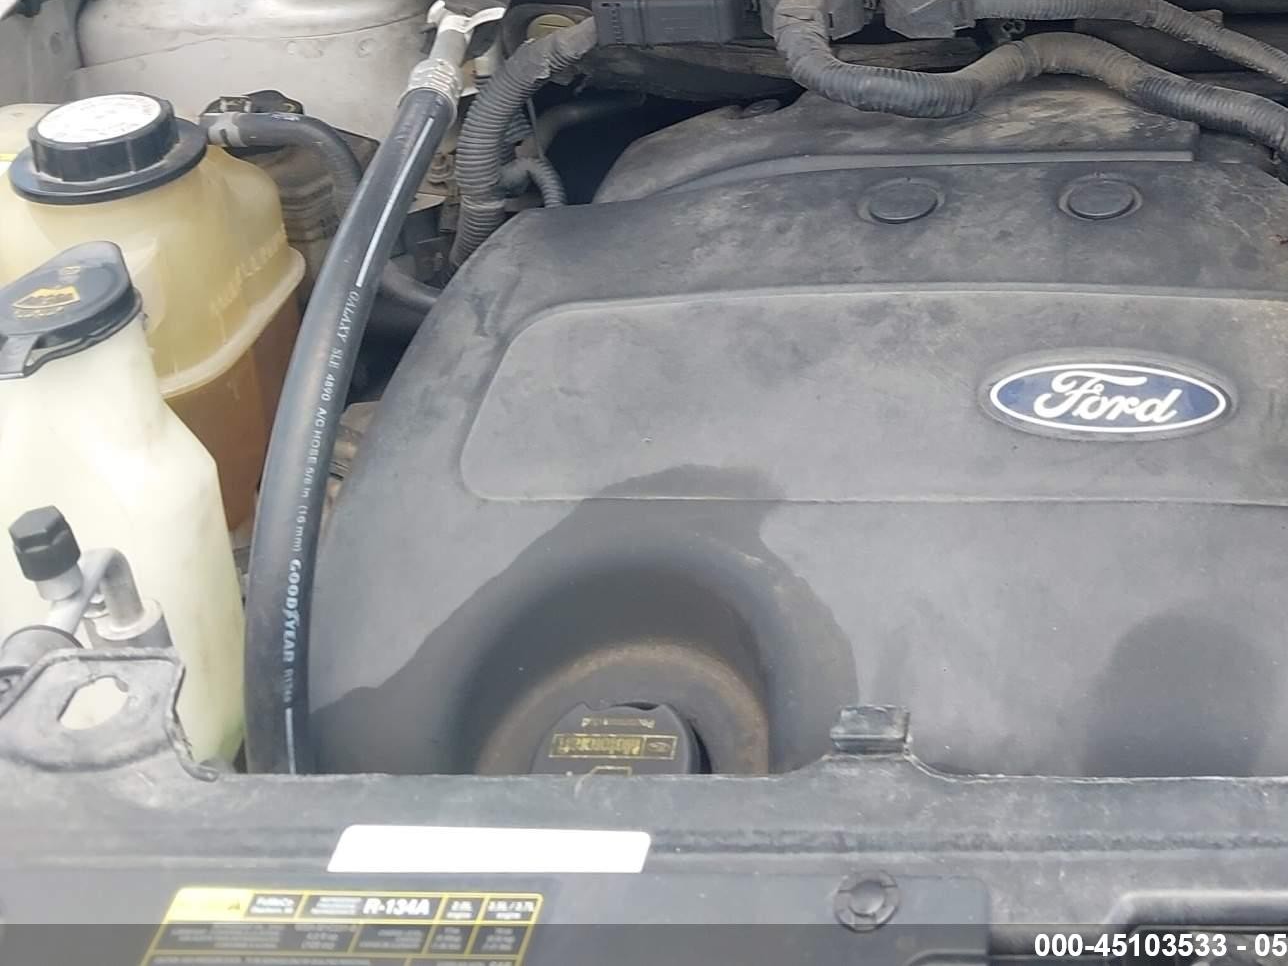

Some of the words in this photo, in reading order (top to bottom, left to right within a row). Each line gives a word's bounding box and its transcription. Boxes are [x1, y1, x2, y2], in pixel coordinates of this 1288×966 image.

[1033, 370, 1182, 423] Ford
[314, 406, 328, 428] A/C
[282, 558, 303, 663] GOODYEAR
[363, 897, 431, 916] R-134A
